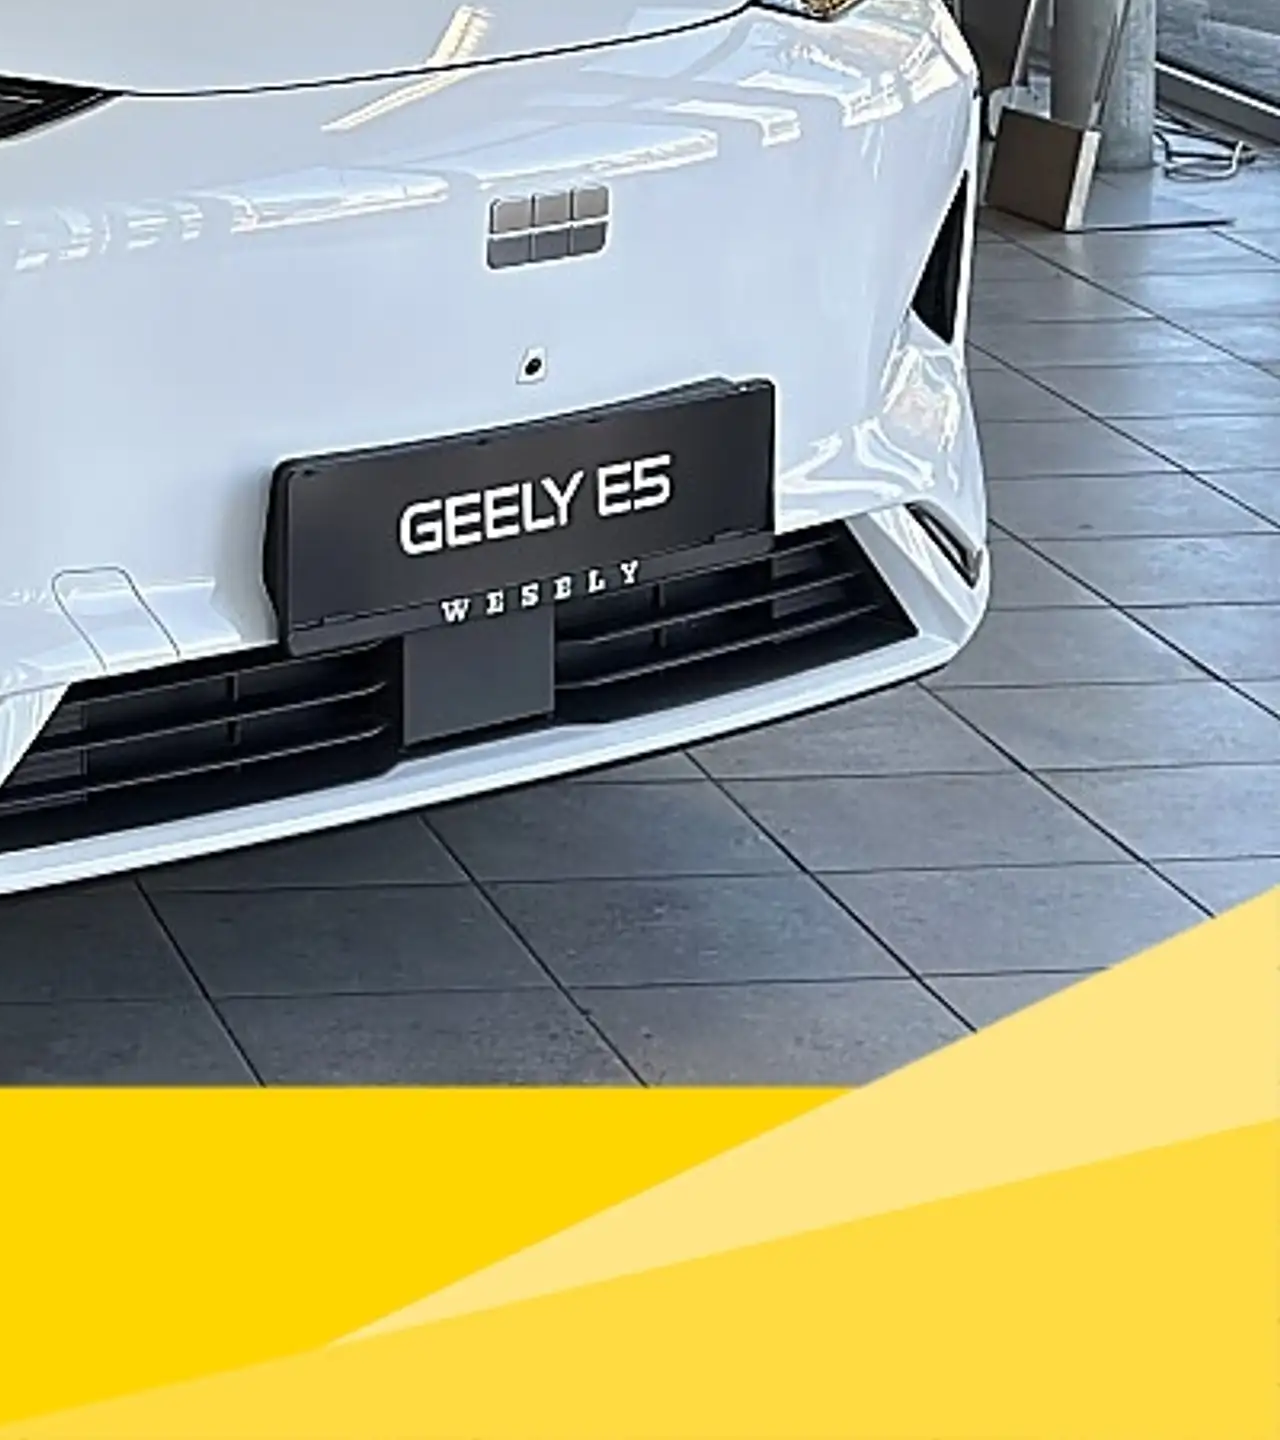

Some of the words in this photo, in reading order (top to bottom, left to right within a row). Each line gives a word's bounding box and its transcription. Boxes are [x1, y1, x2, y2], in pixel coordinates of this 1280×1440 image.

[399, 469, 584, 557] GEELY
[596, 453, 672, 518] E5
[441, 560, 640, 623] WESELY
